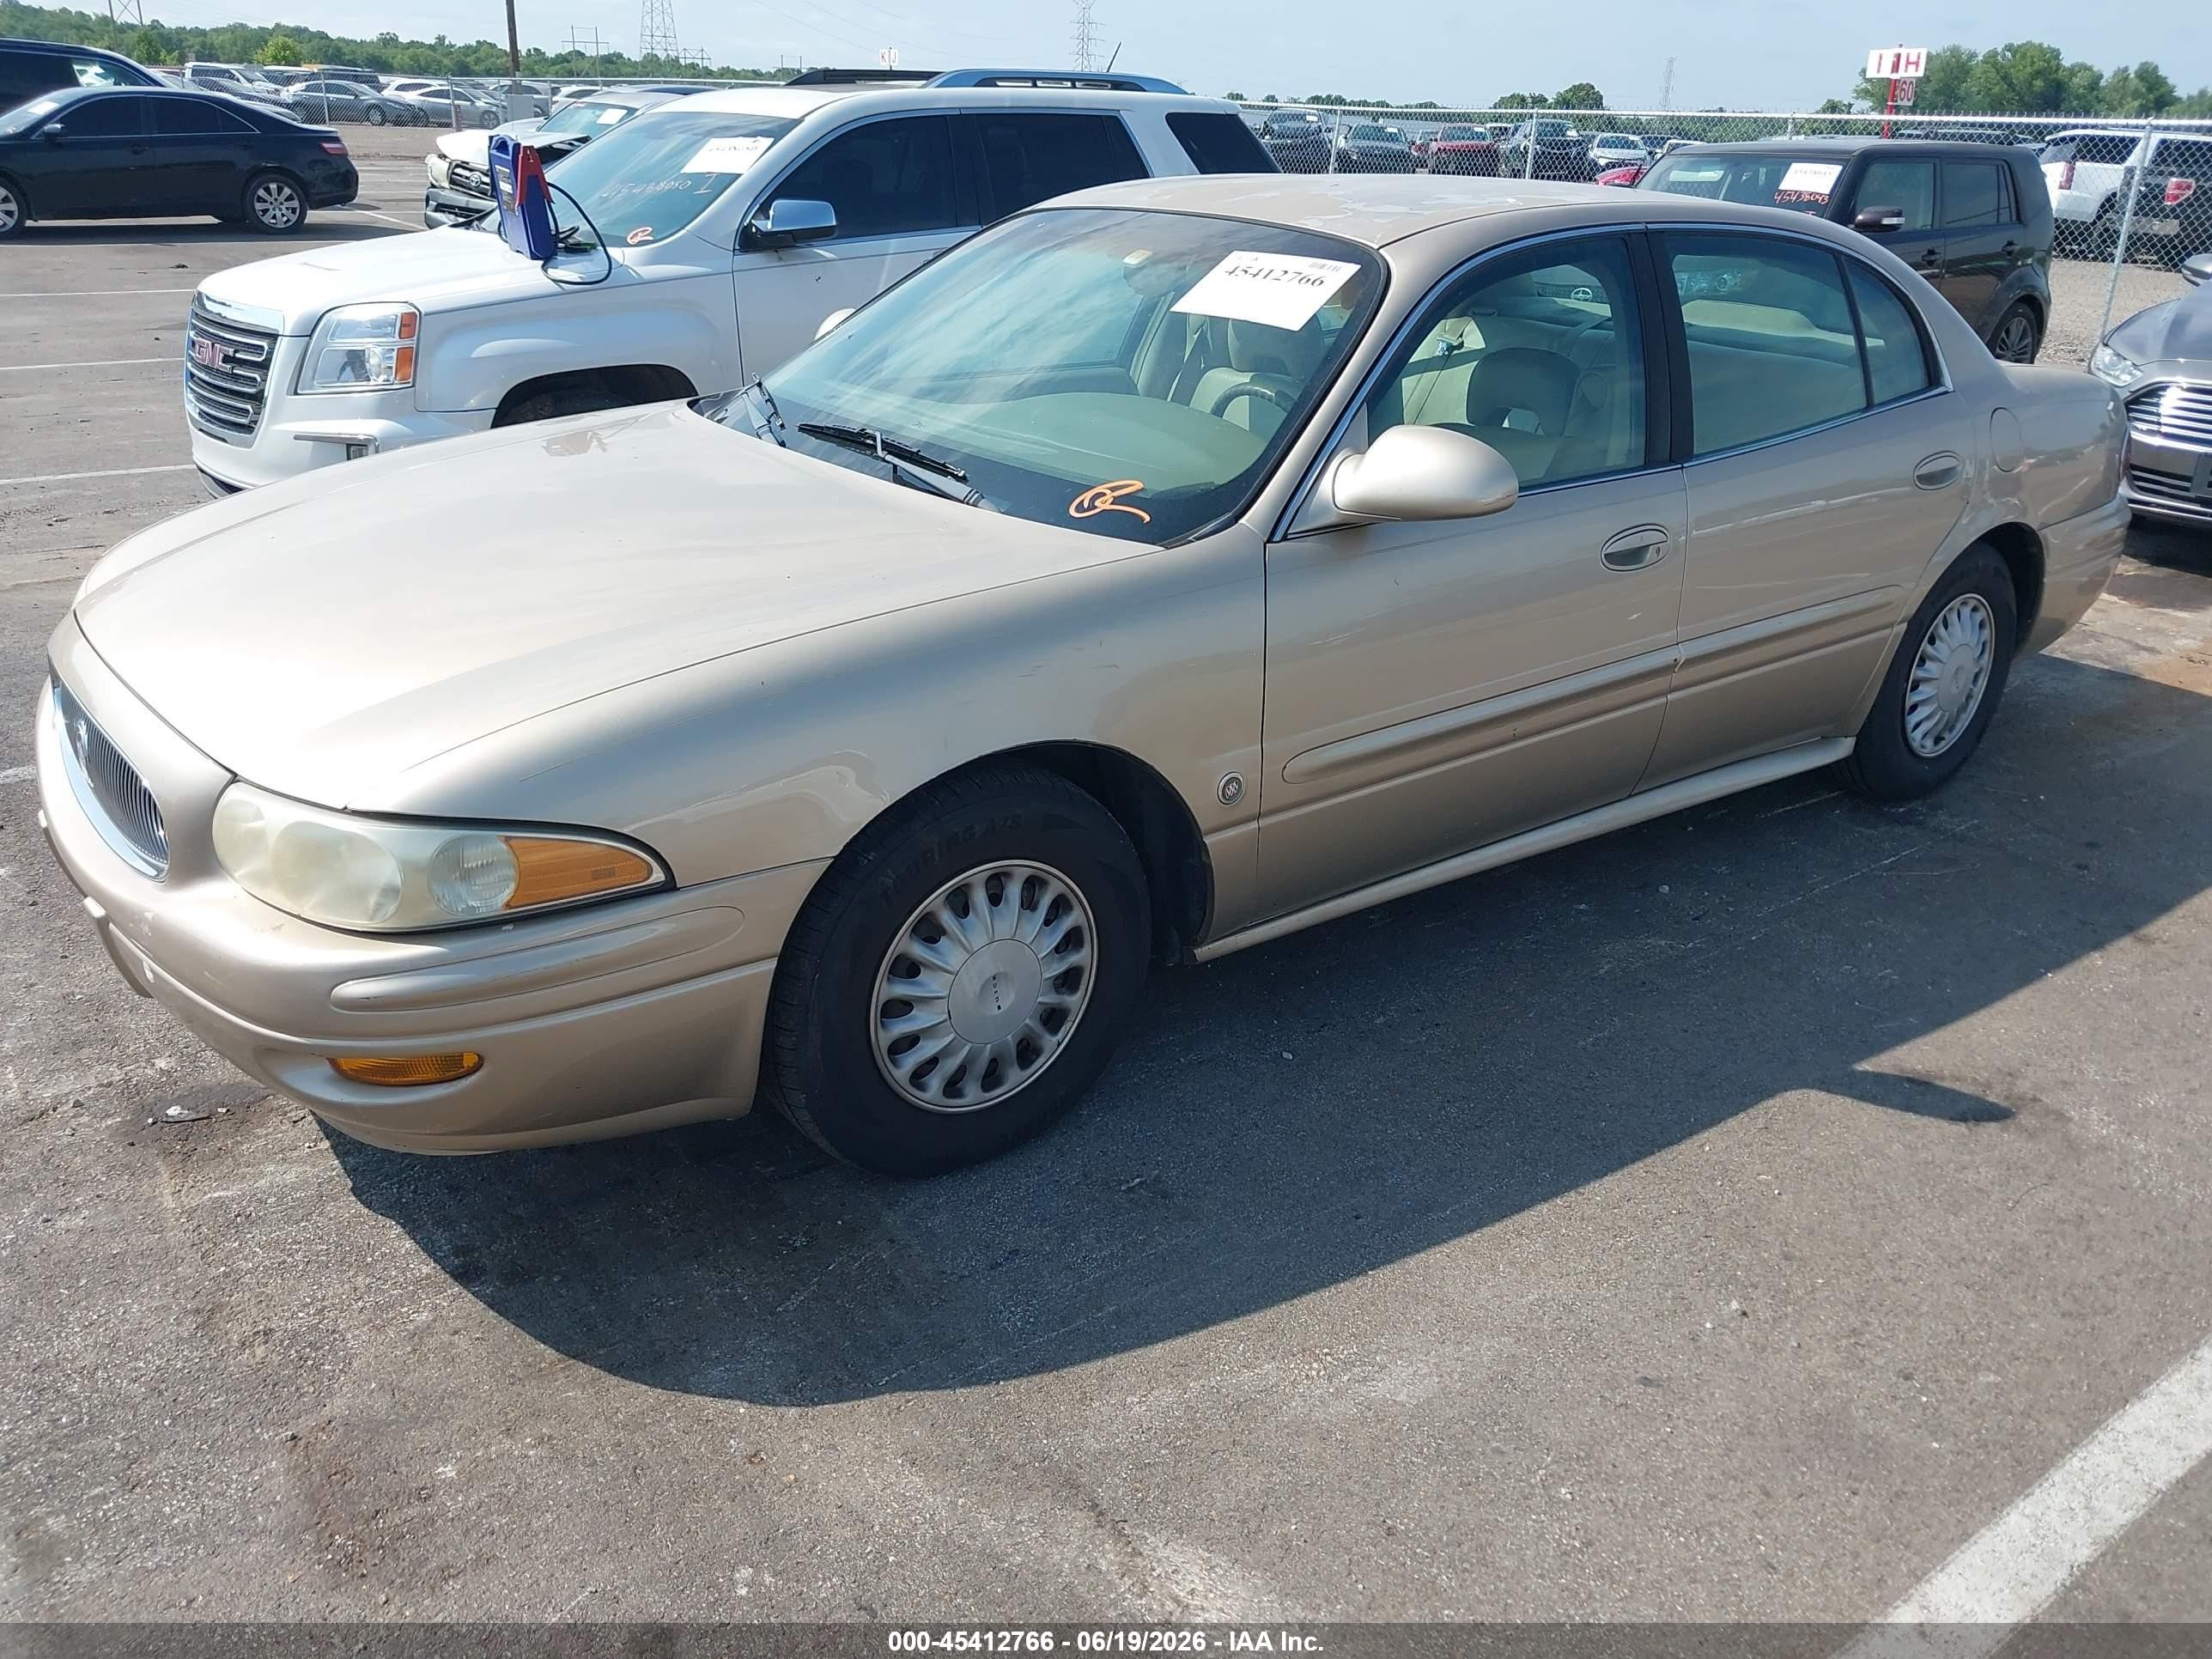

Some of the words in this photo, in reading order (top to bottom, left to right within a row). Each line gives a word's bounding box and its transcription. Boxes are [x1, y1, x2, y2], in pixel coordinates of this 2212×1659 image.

[1905, 52, 1922, 73] H
[1224, 264, 1325, 288] 45412766
[194, 337, 235, 374] GMC
